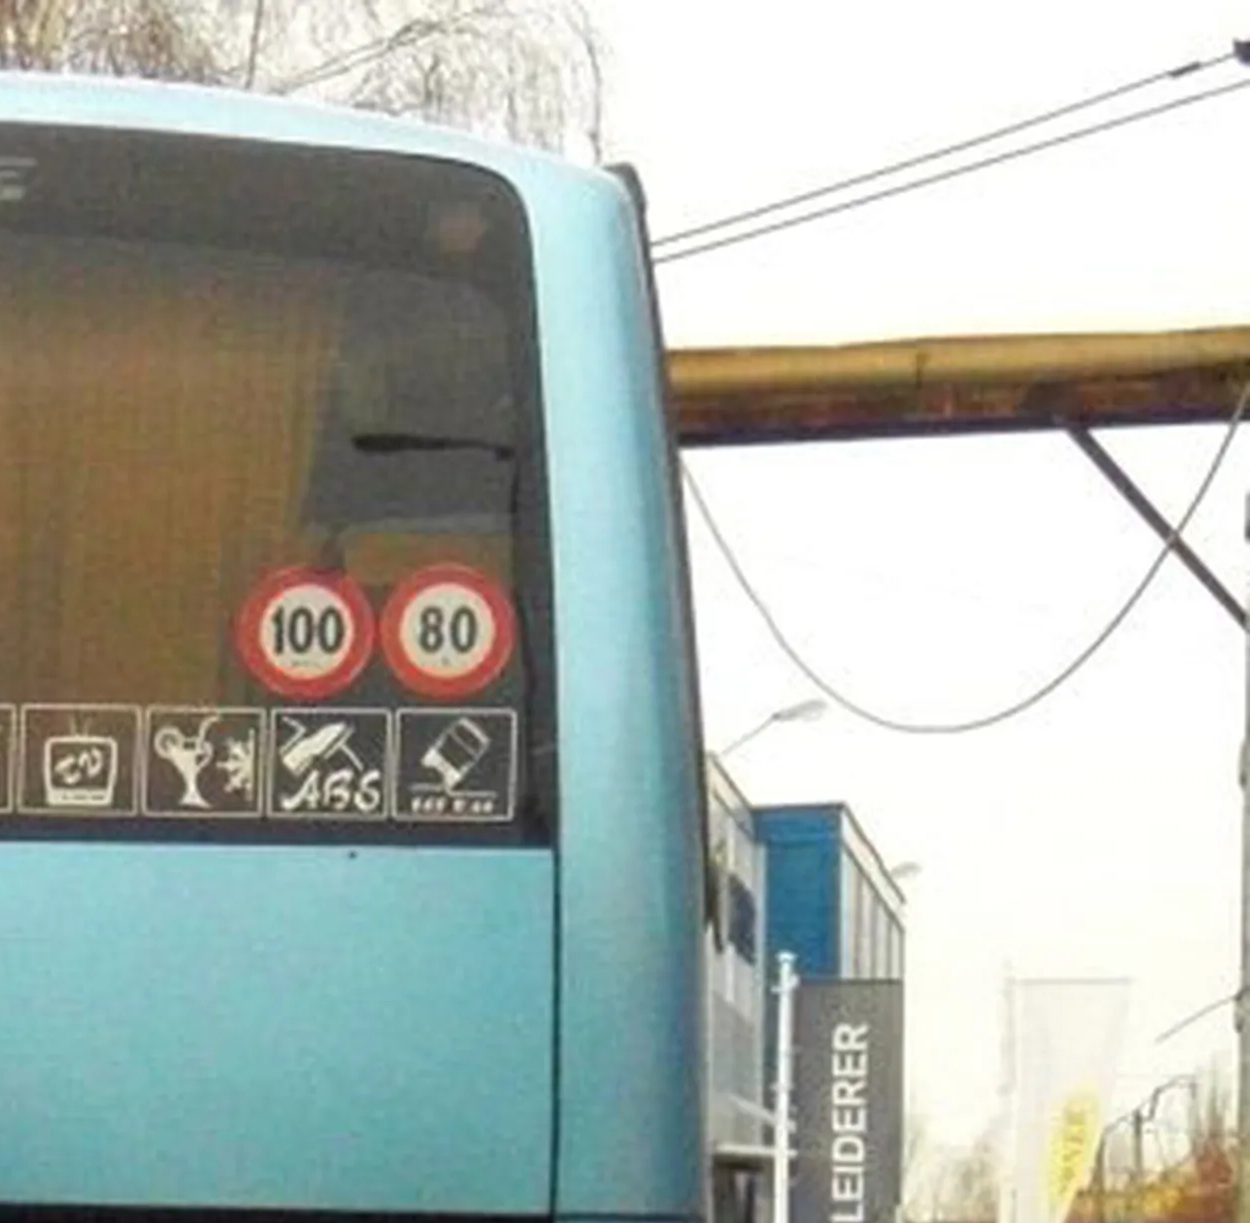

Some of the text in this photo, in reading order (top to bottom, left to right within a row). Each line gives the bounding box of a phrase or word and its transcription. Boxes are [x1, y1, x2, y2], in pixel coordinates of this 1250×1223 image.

[271, 605, 345, 654] 100
[418, 605, 478, 653] 80
[281, 769, 382, 812] ABS
